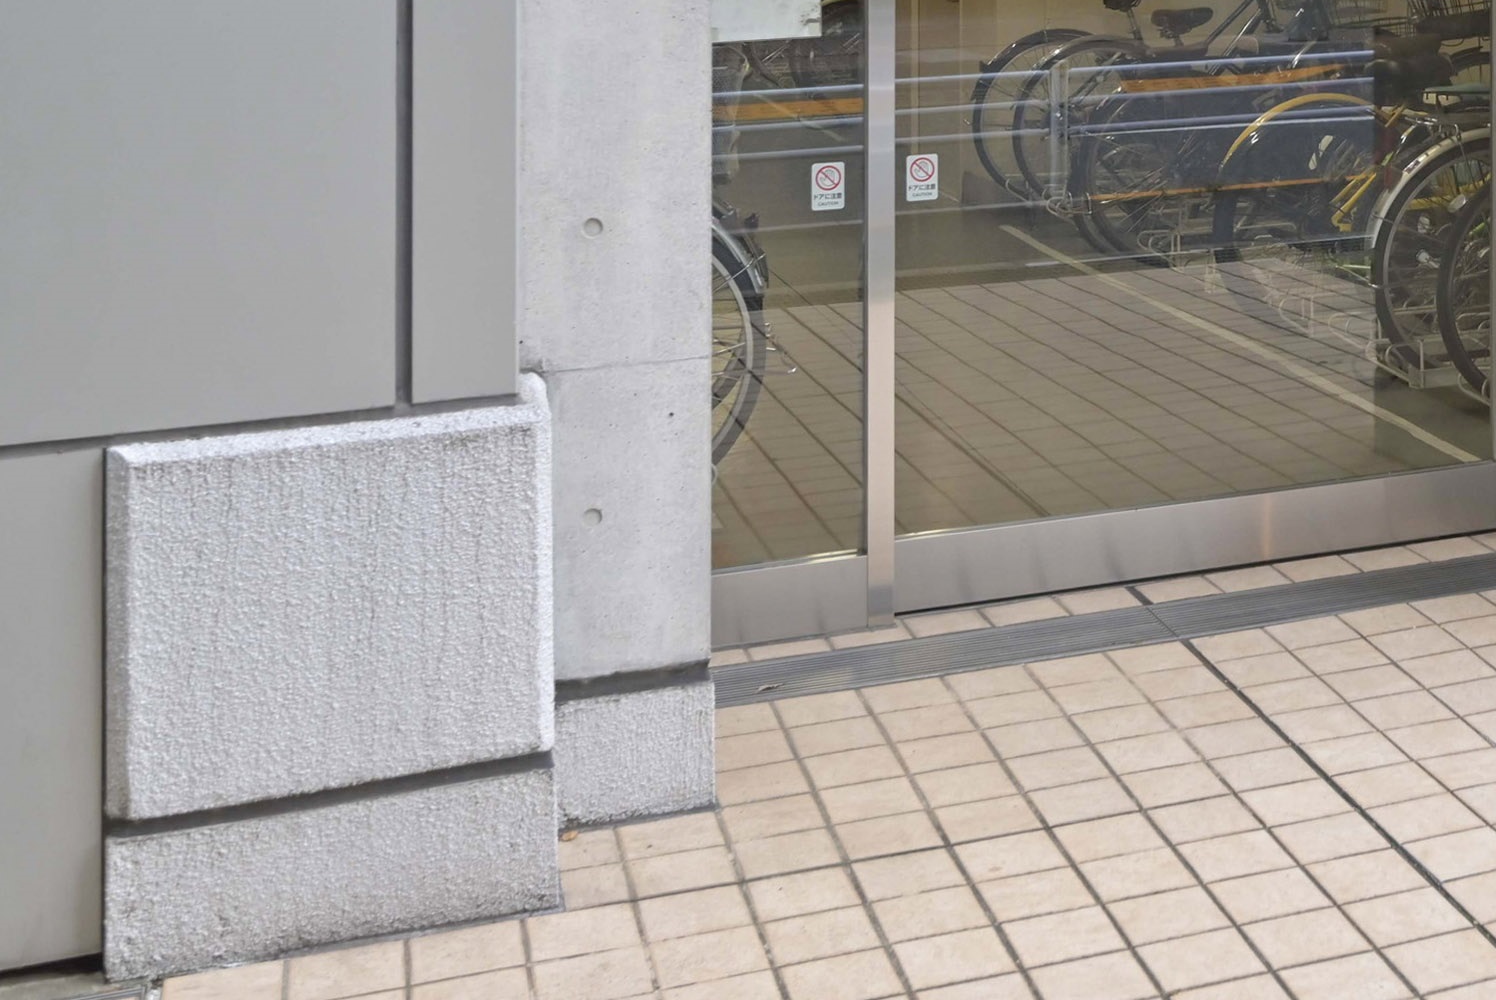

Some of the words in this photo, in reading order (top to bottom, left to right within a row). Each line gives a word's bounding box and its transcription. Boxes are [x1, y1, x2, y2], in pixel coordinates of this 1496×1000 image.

[908, 183, 936, 191] ドアに注意
[813, 192, 842, 200] ドアに注意
